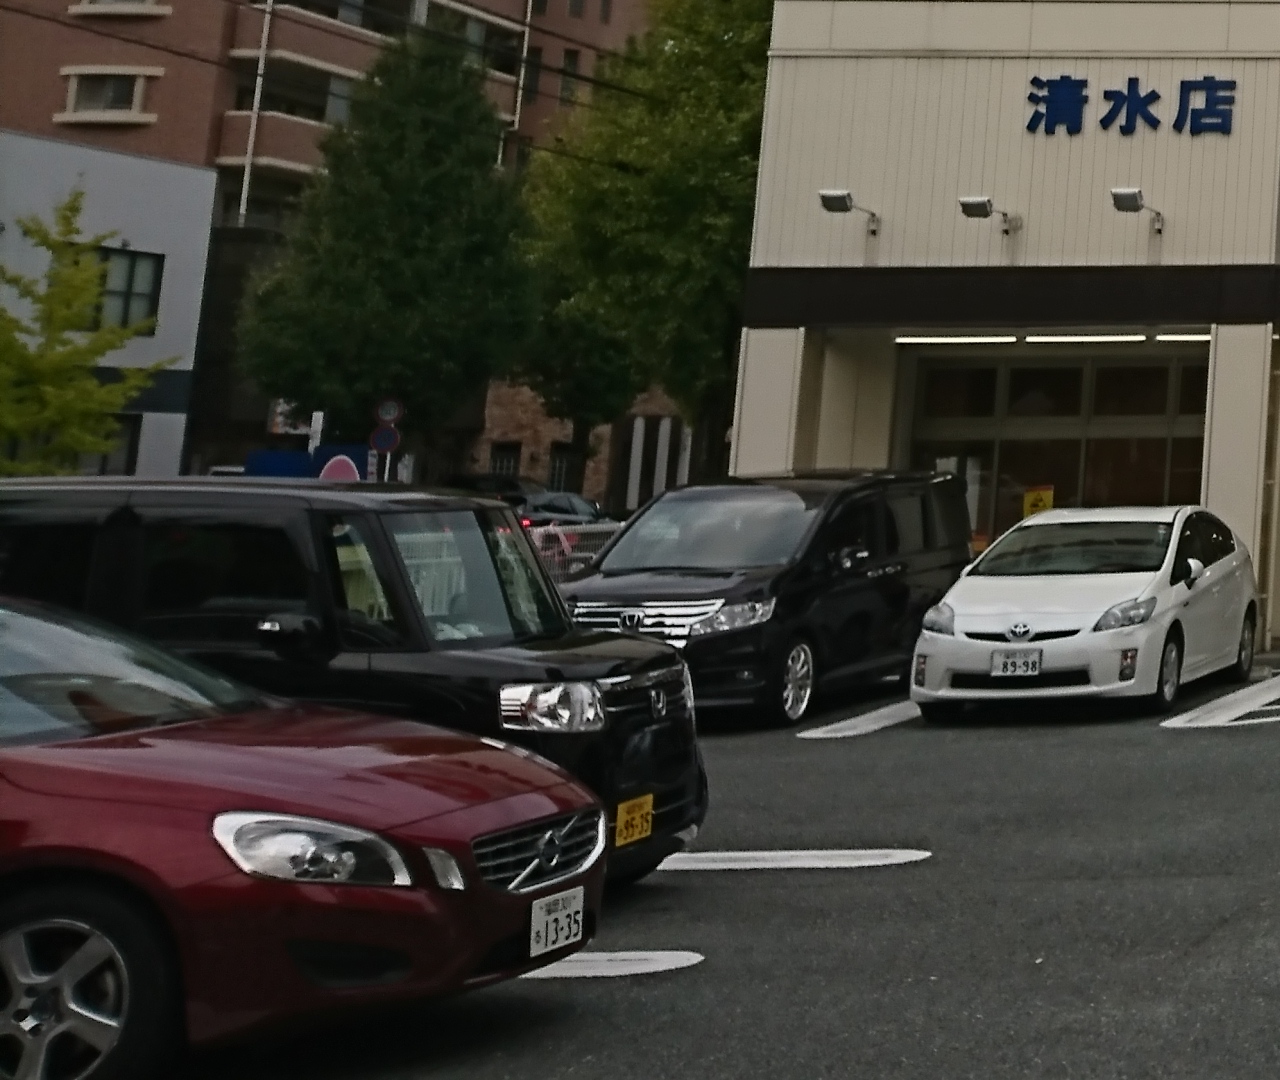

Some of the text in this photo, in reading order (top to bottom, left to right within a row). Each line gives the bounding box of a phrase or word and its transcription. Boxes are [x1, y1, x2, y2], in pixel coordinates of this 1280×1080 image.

[1026, 75, 1236, 136] 清水店
[1002, 660, 1037, 673] 89-98
[544, 909, 581, 948] 13-35
